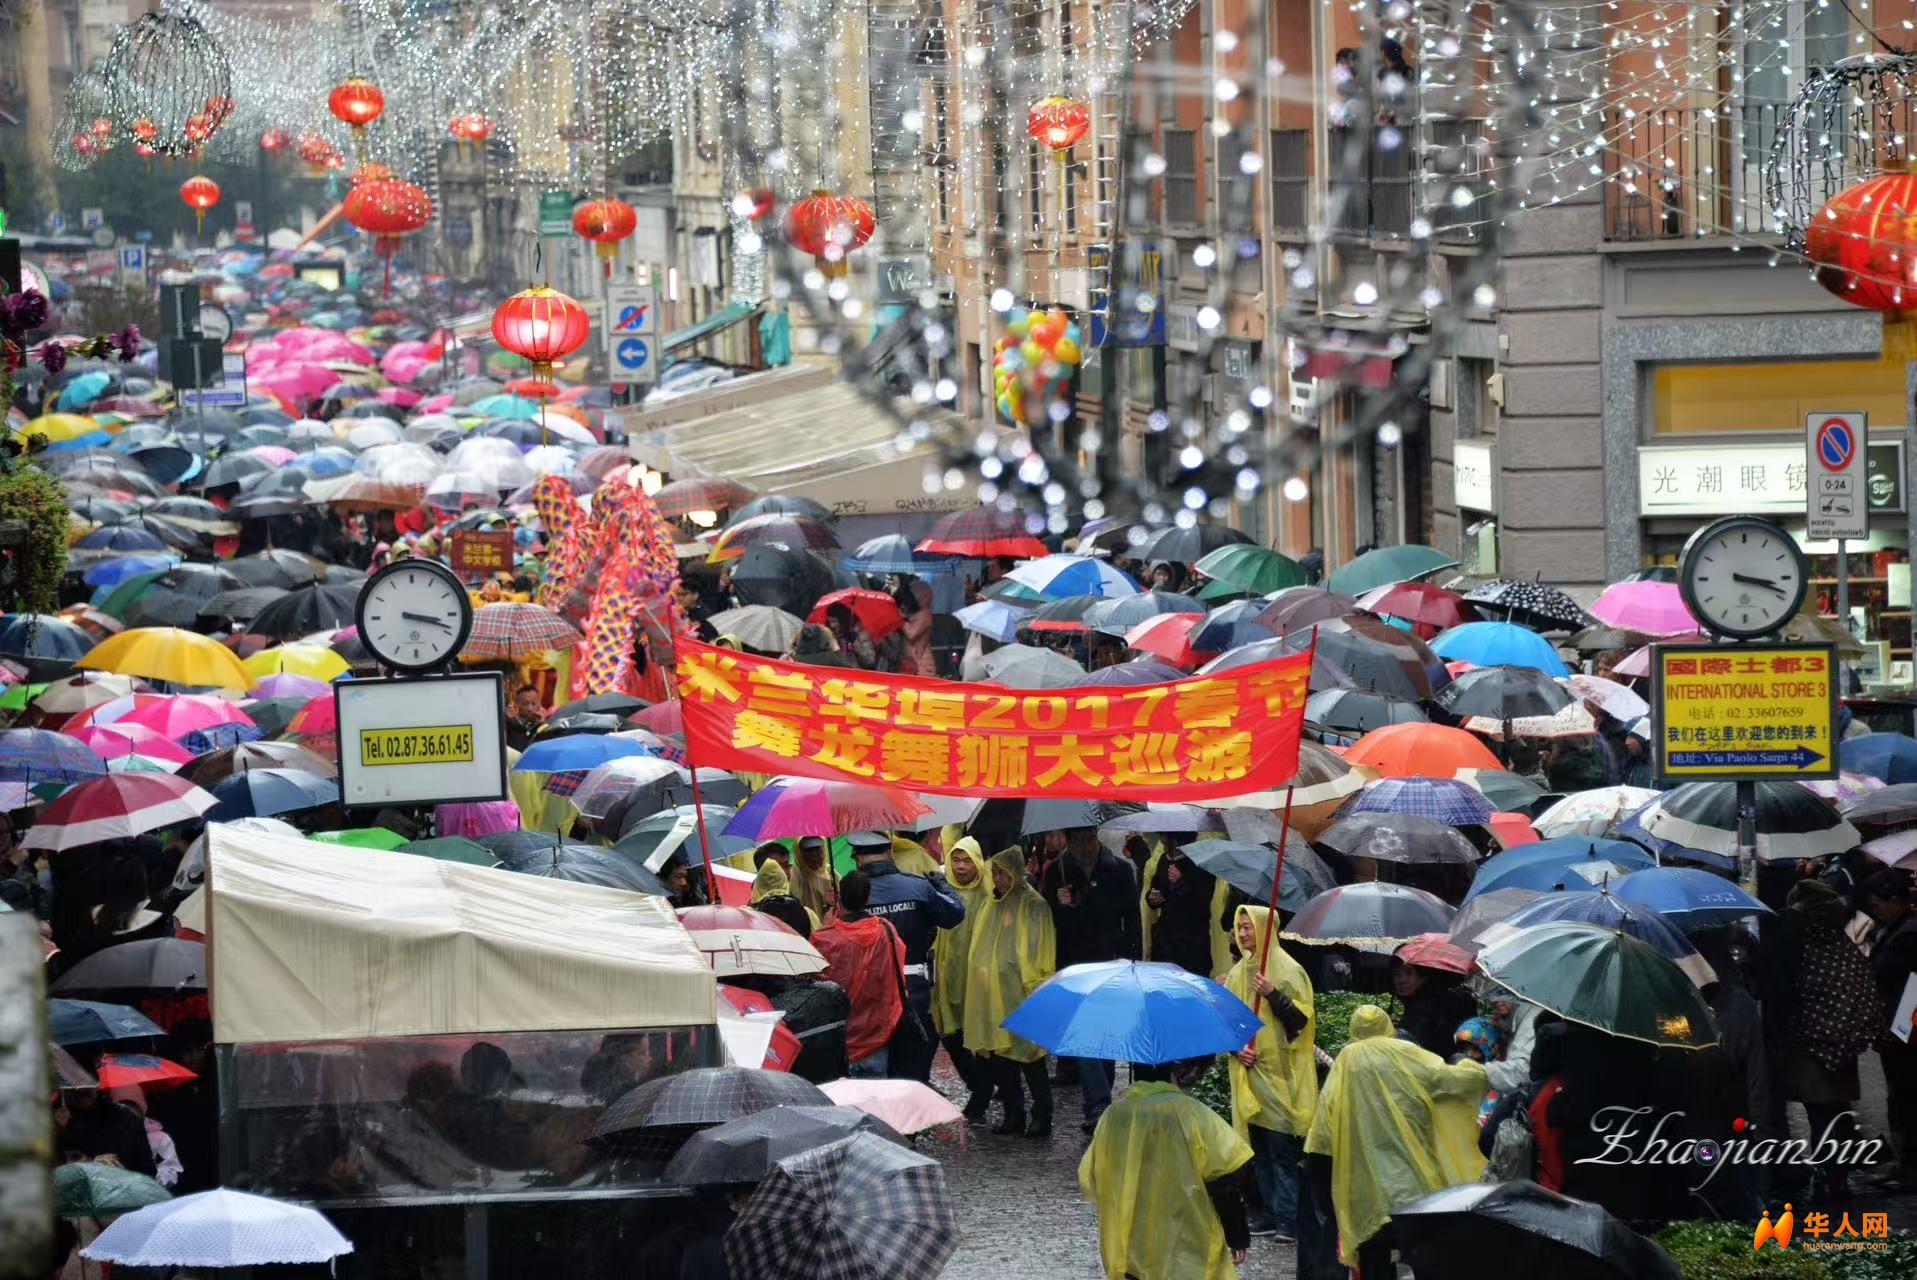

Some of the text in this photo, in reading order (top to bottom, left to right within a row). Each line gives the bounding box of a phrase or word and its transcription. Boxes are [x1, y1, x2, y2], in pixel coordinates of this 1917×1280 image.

[676, 653, 1312, 733] 米兰华埠2017春节
[1667, 682, 1826, 700] INTERNATIONAL STORE 3
[364, 733, 469, 758] Tel. 02.87.36.61.45
[733, 710, 1252, 788] 舞龙舞狮大巡游
[1704, 753, 1725, 762] Via
[1727, 753, 1757, 763] Paolo
[1759, 752, 1788, 764] Sarpi
[1790, 752, 1804, 761] 44
[888, 902, 916, 913] LOCALE
